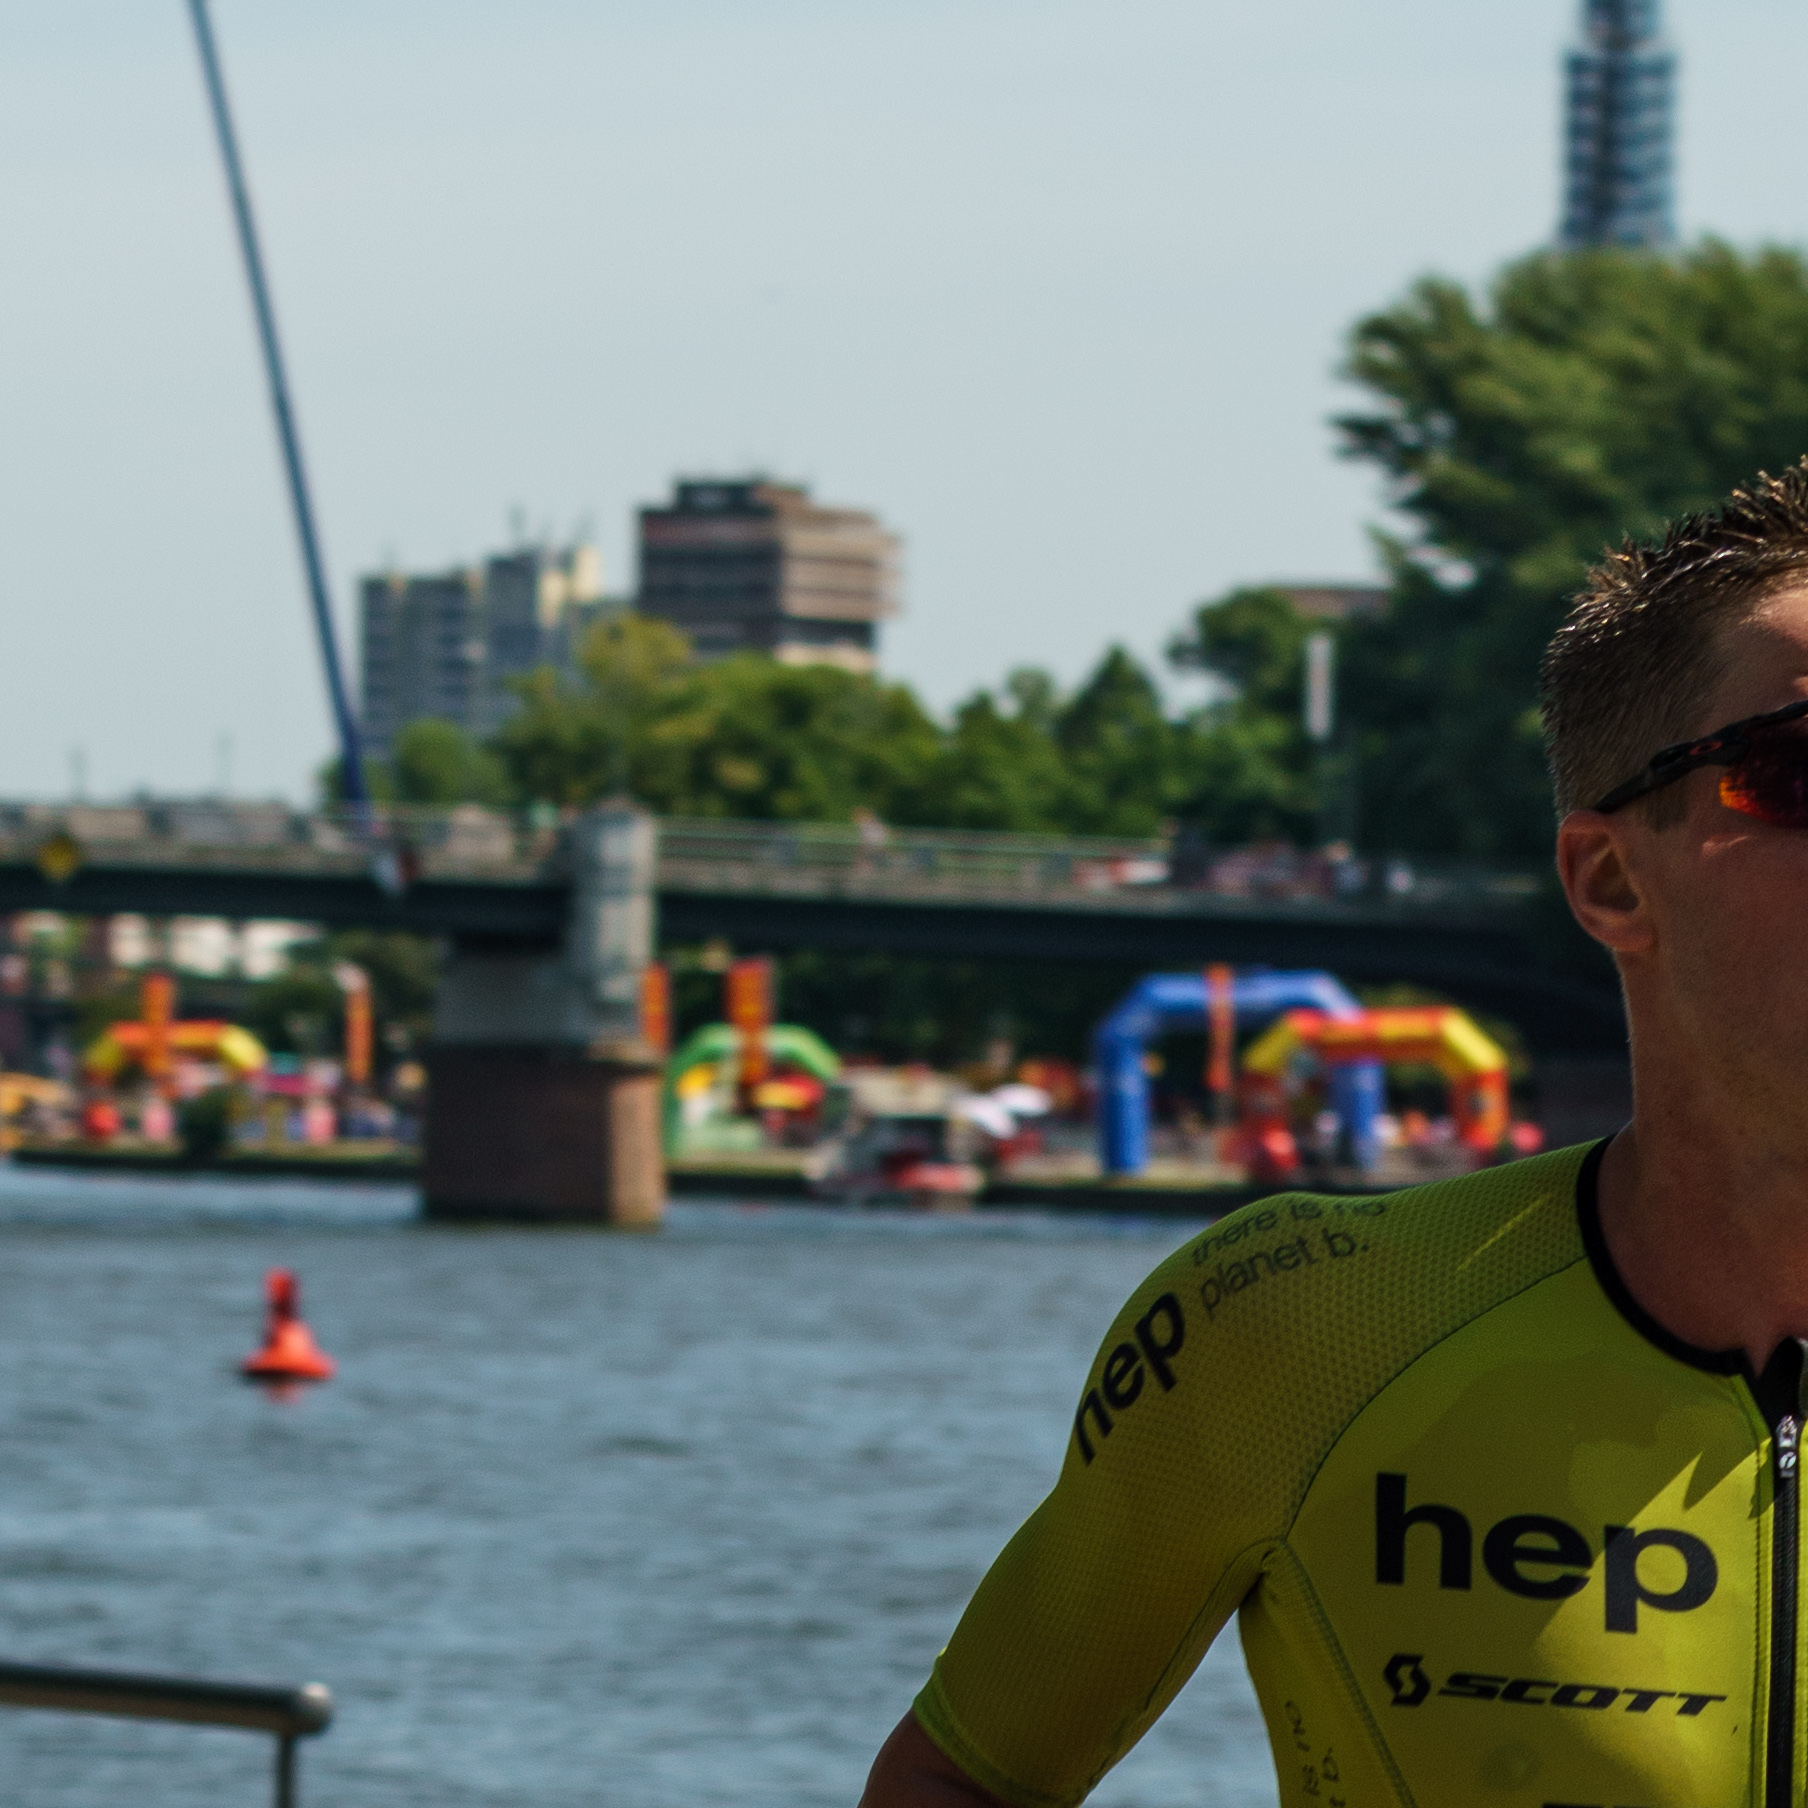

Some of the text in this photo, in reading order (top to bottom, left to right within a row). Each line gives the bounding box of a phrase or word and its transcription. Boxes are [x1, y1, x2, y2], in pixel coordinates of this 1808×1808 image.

[1200, 1227, 1371, 1321] planet b.
[1374, 1471, 1719, 1635] hep
[1436, 1671, 1728, 1717] SCOTT
